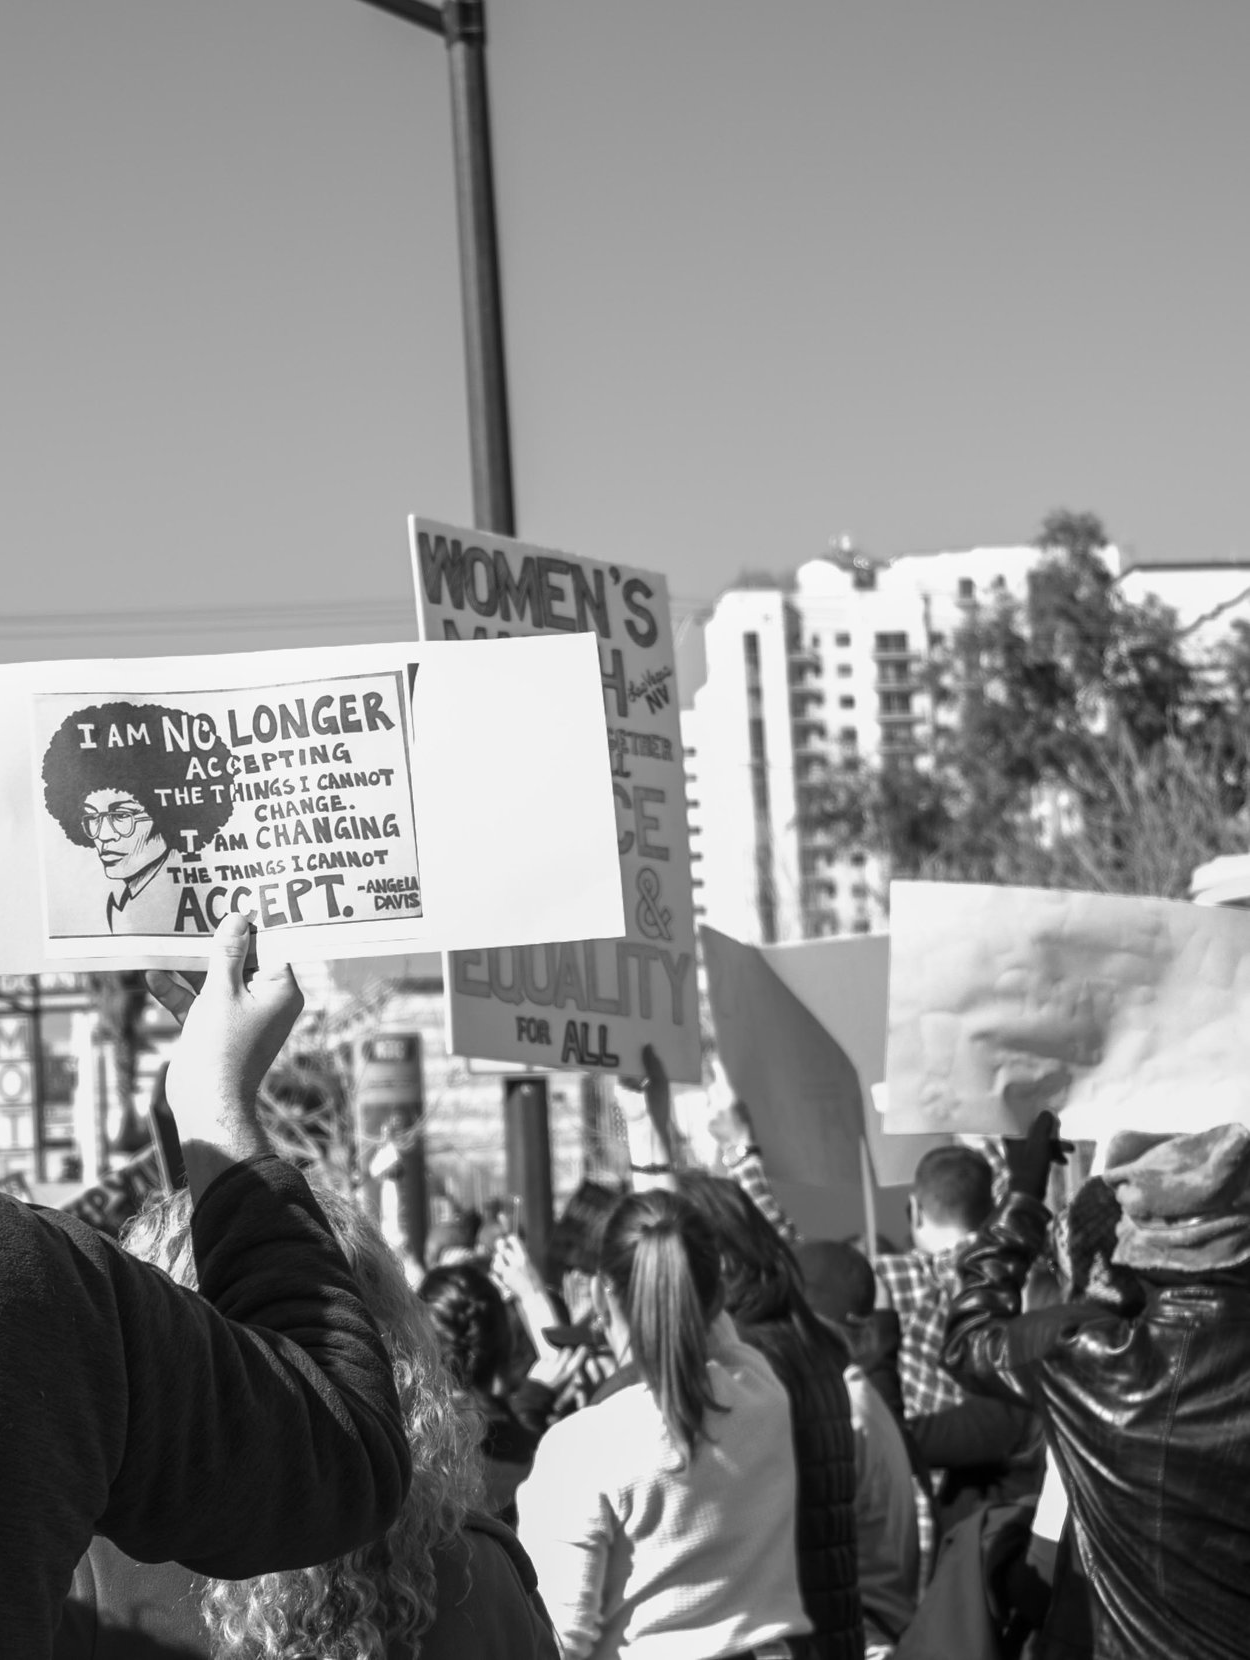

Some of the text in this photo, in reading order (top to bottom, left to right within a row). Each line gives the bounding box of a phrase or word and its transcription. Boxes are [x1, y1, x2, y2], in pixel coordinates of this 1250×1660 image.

[417, 531, 658, 648] WOMEN'S
[77, 692, 396, 752] I AM NO LONGER
[645, 683, 670, 715] NV
[186, 743, 352, 780] ACCEPTING
[154, 769, 395, 806] THE THINGS I CANNOT
[254, 795, 356, 822] CHANGE.
[179, 813, 400, 863] I AM CHANGING
[167, 850, 389, 884] THE THINGS I CANNOT
[174, 874, 354, 933] ACCEPT.
[374, 893, 421, 912] DAVIS
[636, 867, 673, 942] &
[454, 940, 691, 1026] EQUALITY
[515, 1016, 620, 1068] FOR ALL
